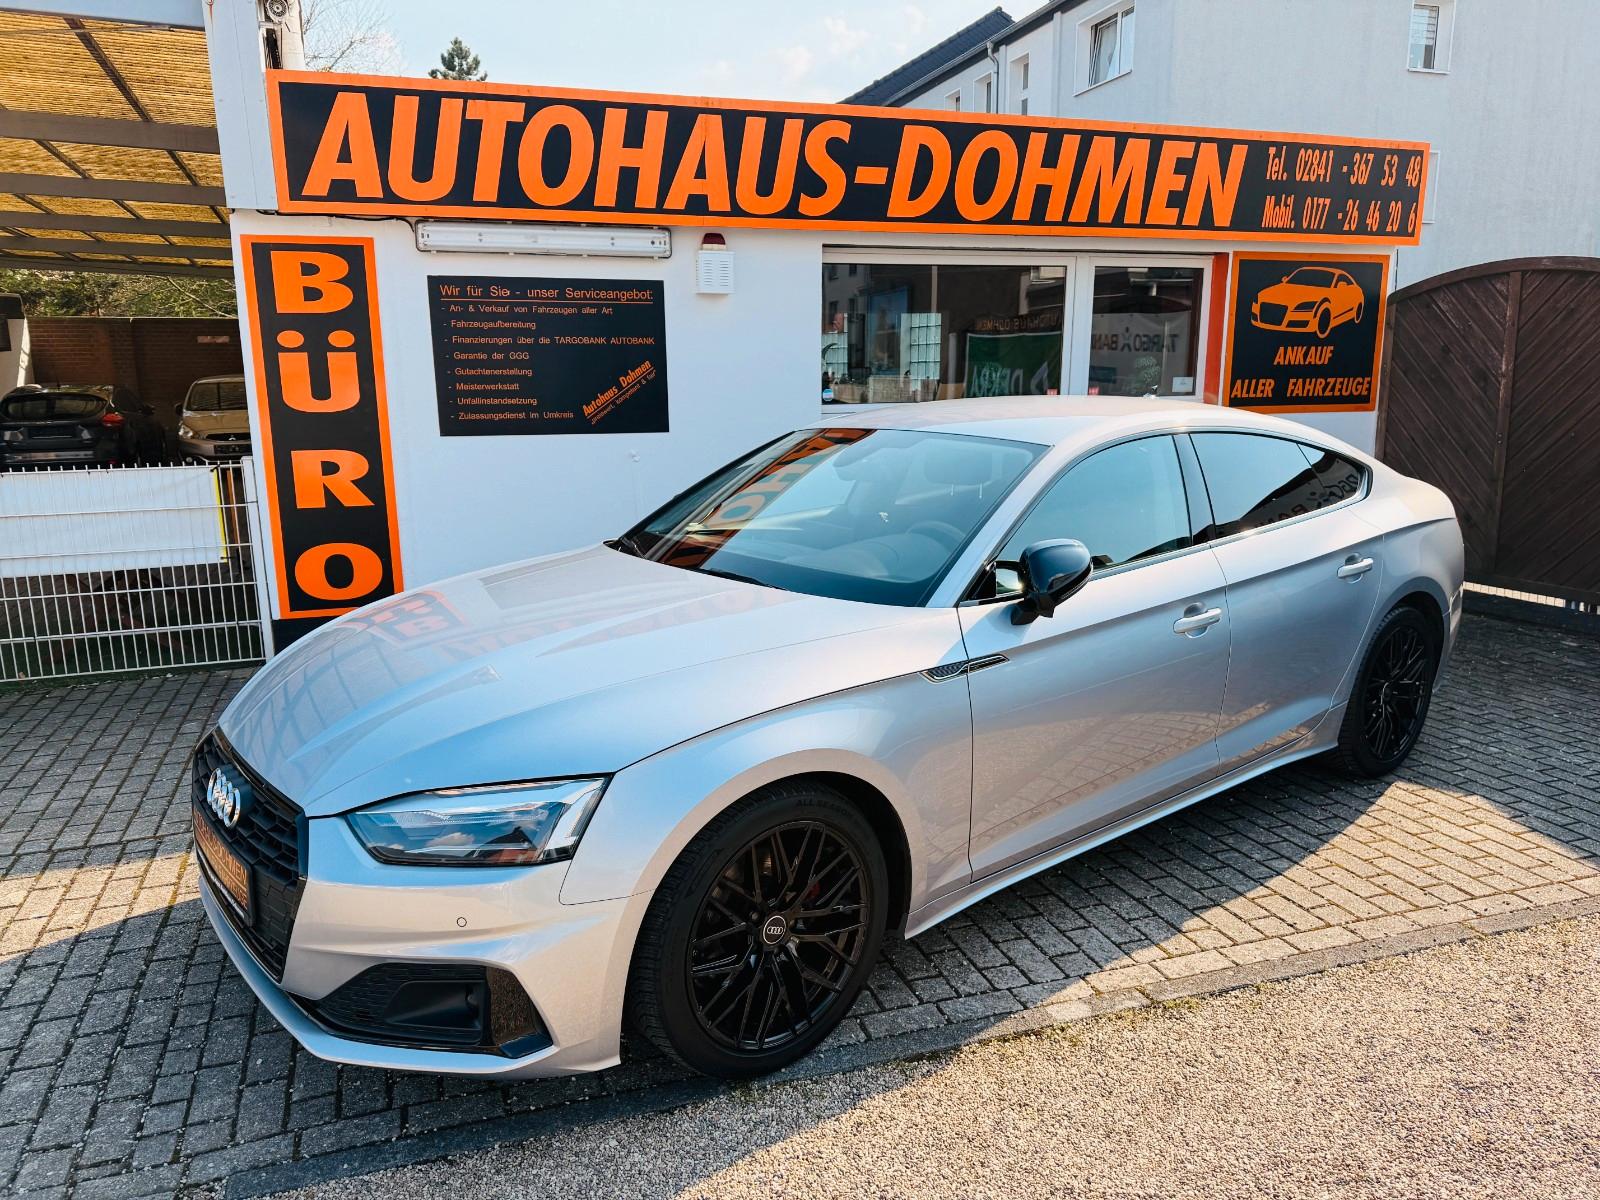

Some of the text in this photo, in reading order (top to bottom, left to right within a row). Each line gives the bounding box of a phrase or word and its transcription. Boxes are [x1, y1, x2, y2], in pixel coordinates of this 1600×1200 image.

[301, 91, 1249, 227] AUTOHAUS-DOHMEN
[1265, 145, 1288, 181] Tel.
[1295, 147, 1334, 183] 02841
[1380, 154, 1399, 187] 53
[1405, 155, 1422, 188] 48
[1261, 193, 1295, 229] Mobil.
[1302, 196, 1331, 230] 0177
[1365, 200, 1381, 232] 46
[1385, 201, 1402, 233] 20
[1407, 202, 1417, 233] 6
[440, 285, 461, 296] Wir
[466, 285, 483, 297] für
[489, 285, 509, 297] Sie
[527, 289, 560, 298] unser
[565, 287, 653, 302] Serviceangebot:
[449, 304, 464, 312] An-
[468, 304, 475, 312] &
[479, 304, 510, 313] Verkauf
[532, 305, 578, 315] Fahrzeugen
[581, 306, 598, 314] aller
[601, 306, 613, 315] Art
[450, 319, 536, 330] Fahrzeugaufbereitung
[452, 335, 655, 345] Finanzierungen über die TARGOBANK AUTOBANK
[453, 351, 530, 360] Garantie der GGG
[1273, 345, 1335, 366] ANKAUF
[454, 367, 533, 377] Gutachtenerstellung
[456, 382, 520, 391] Meisterwerkstatt
[582, 360, 652, 417] Autohaus Dohmen
[1230, 377, 1372, 398] ALLER FAHRZEUGE
[457, 397, 538, 406] Unfallinstandsetzung
[458, 411, 526, 421] Zulassungsdienst
[543, 410, 574, 419] Umkreis
[270, 250, 384, 601] BÜRO
